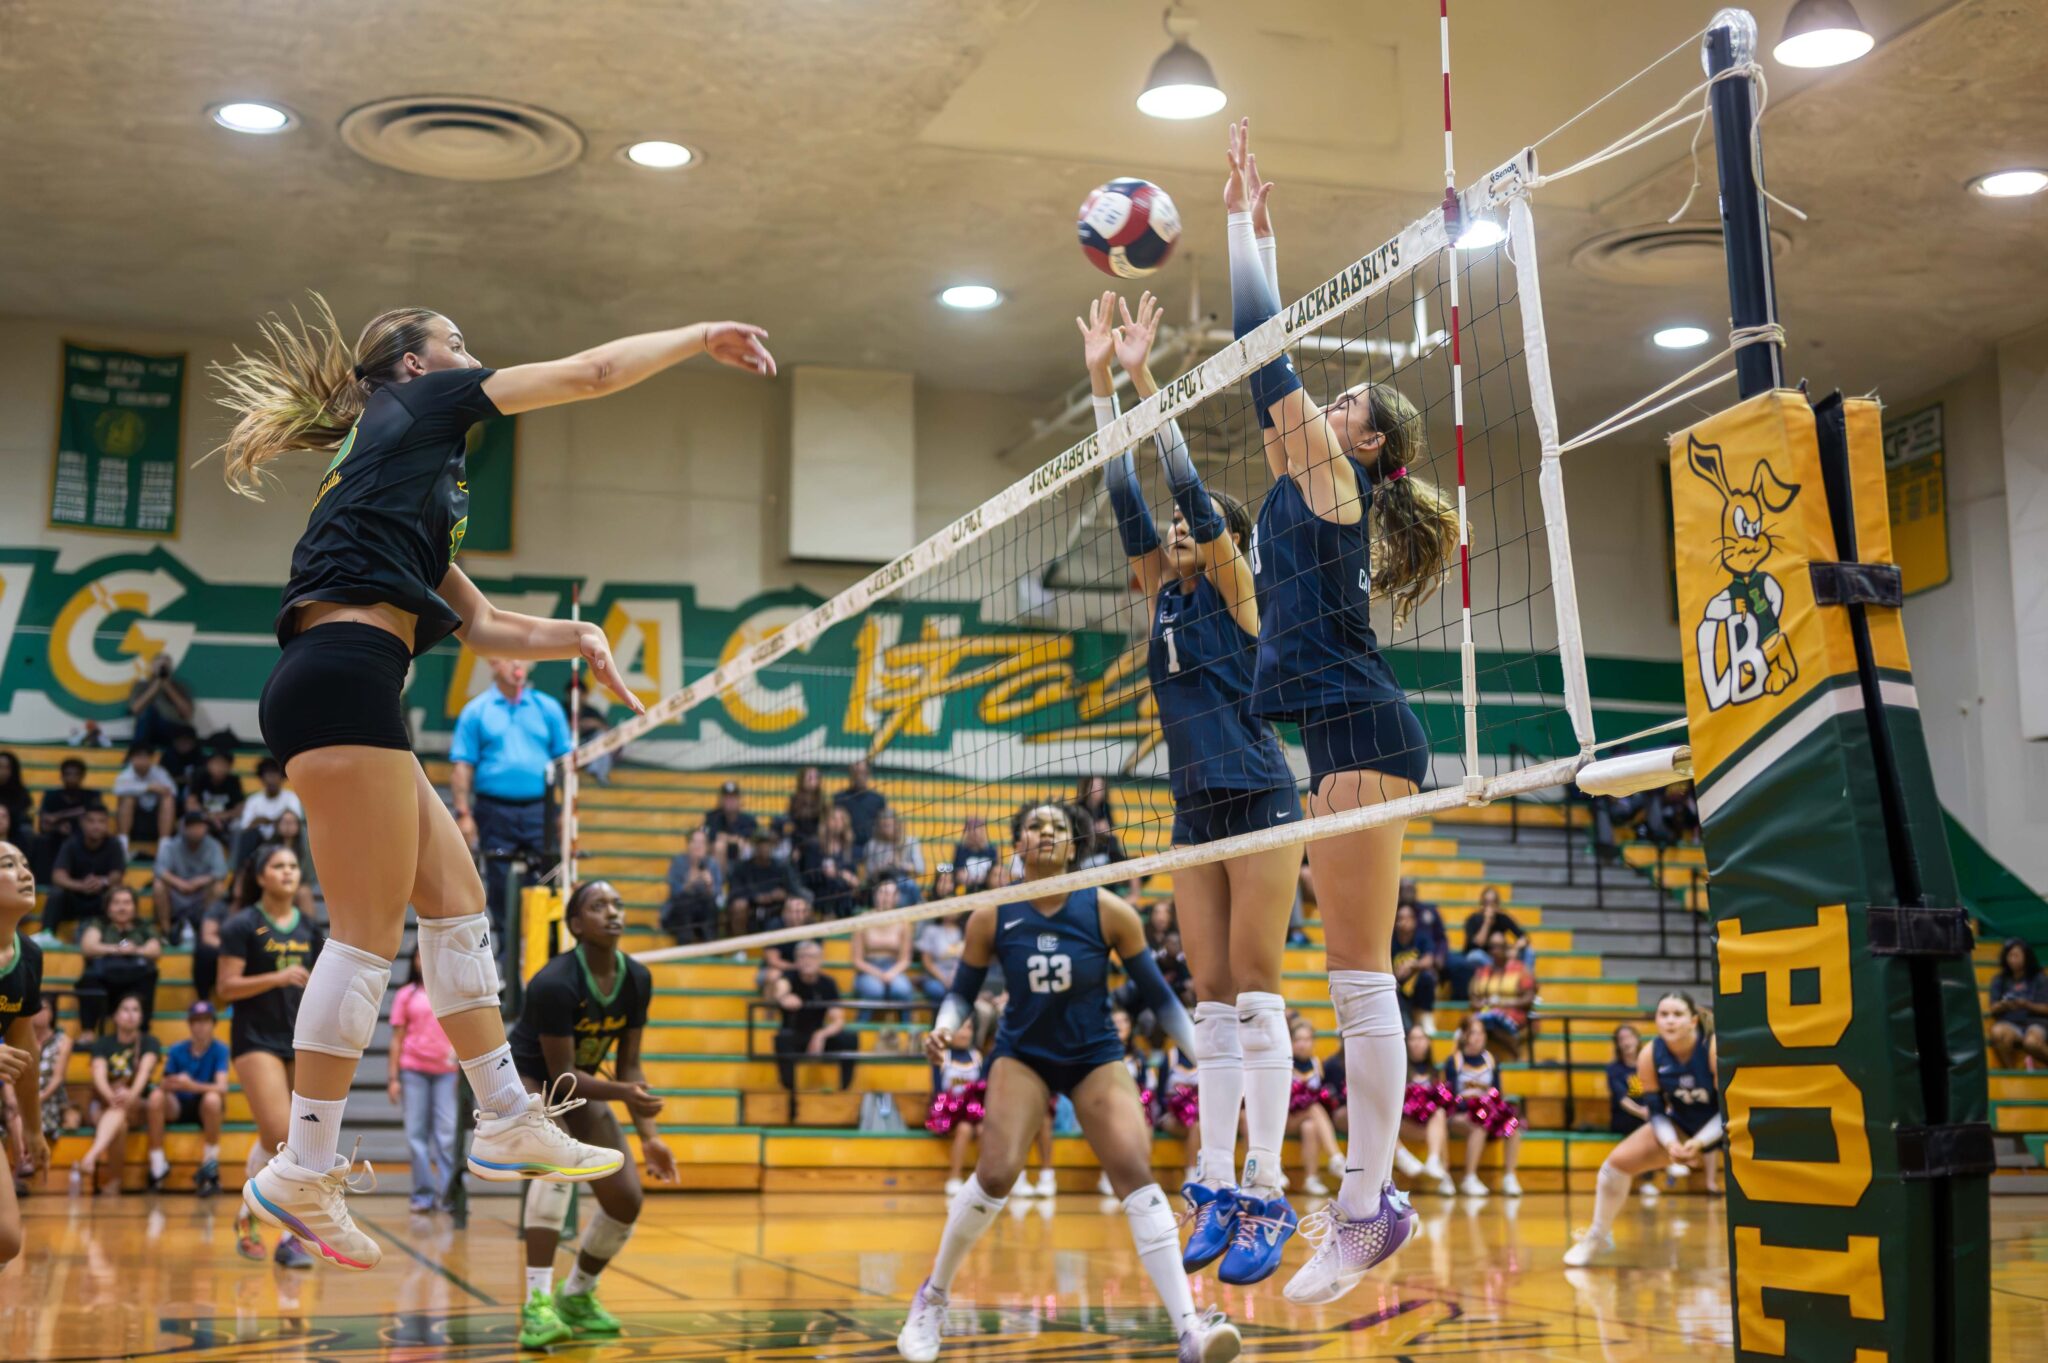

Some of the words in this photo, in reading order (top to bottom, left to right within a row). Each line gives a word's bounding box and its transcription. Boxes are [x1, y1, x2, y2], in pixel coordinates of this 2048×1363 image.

[1285, 237, 1400, 334] JACKRABBITS
[1163, 626, 1181, 673] 1
[1027, 954, 1072, 993] 23
[1715, 903, 1889, 1363] POL
